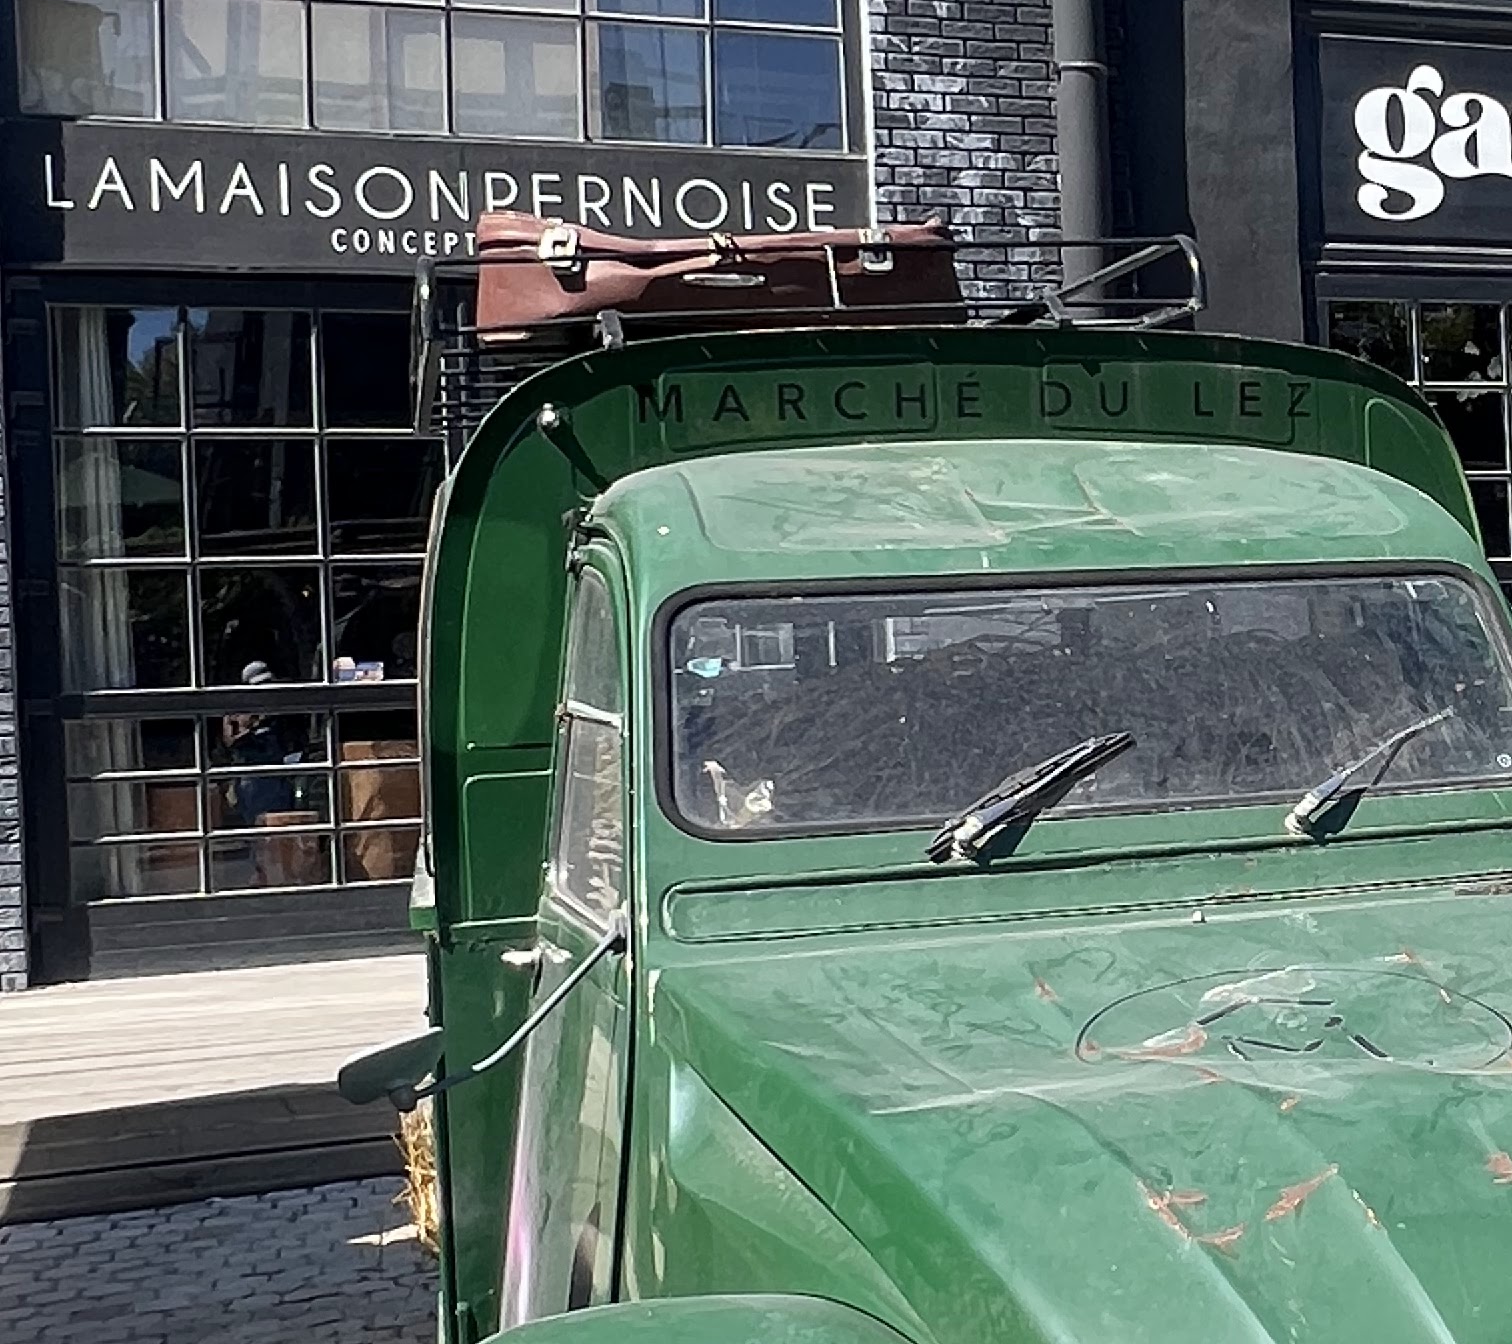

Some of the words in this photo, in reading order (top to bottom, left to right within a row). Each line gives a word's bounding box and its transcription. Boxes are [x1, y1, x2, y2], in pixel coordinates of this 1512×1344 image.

[331, 228, 476, 256] CONCEPT
[638, 371, 983, 423] MARCHÉ
[1040, 381, 1128, 418] DU
[1194, 381, 1312, 418] LEZ
